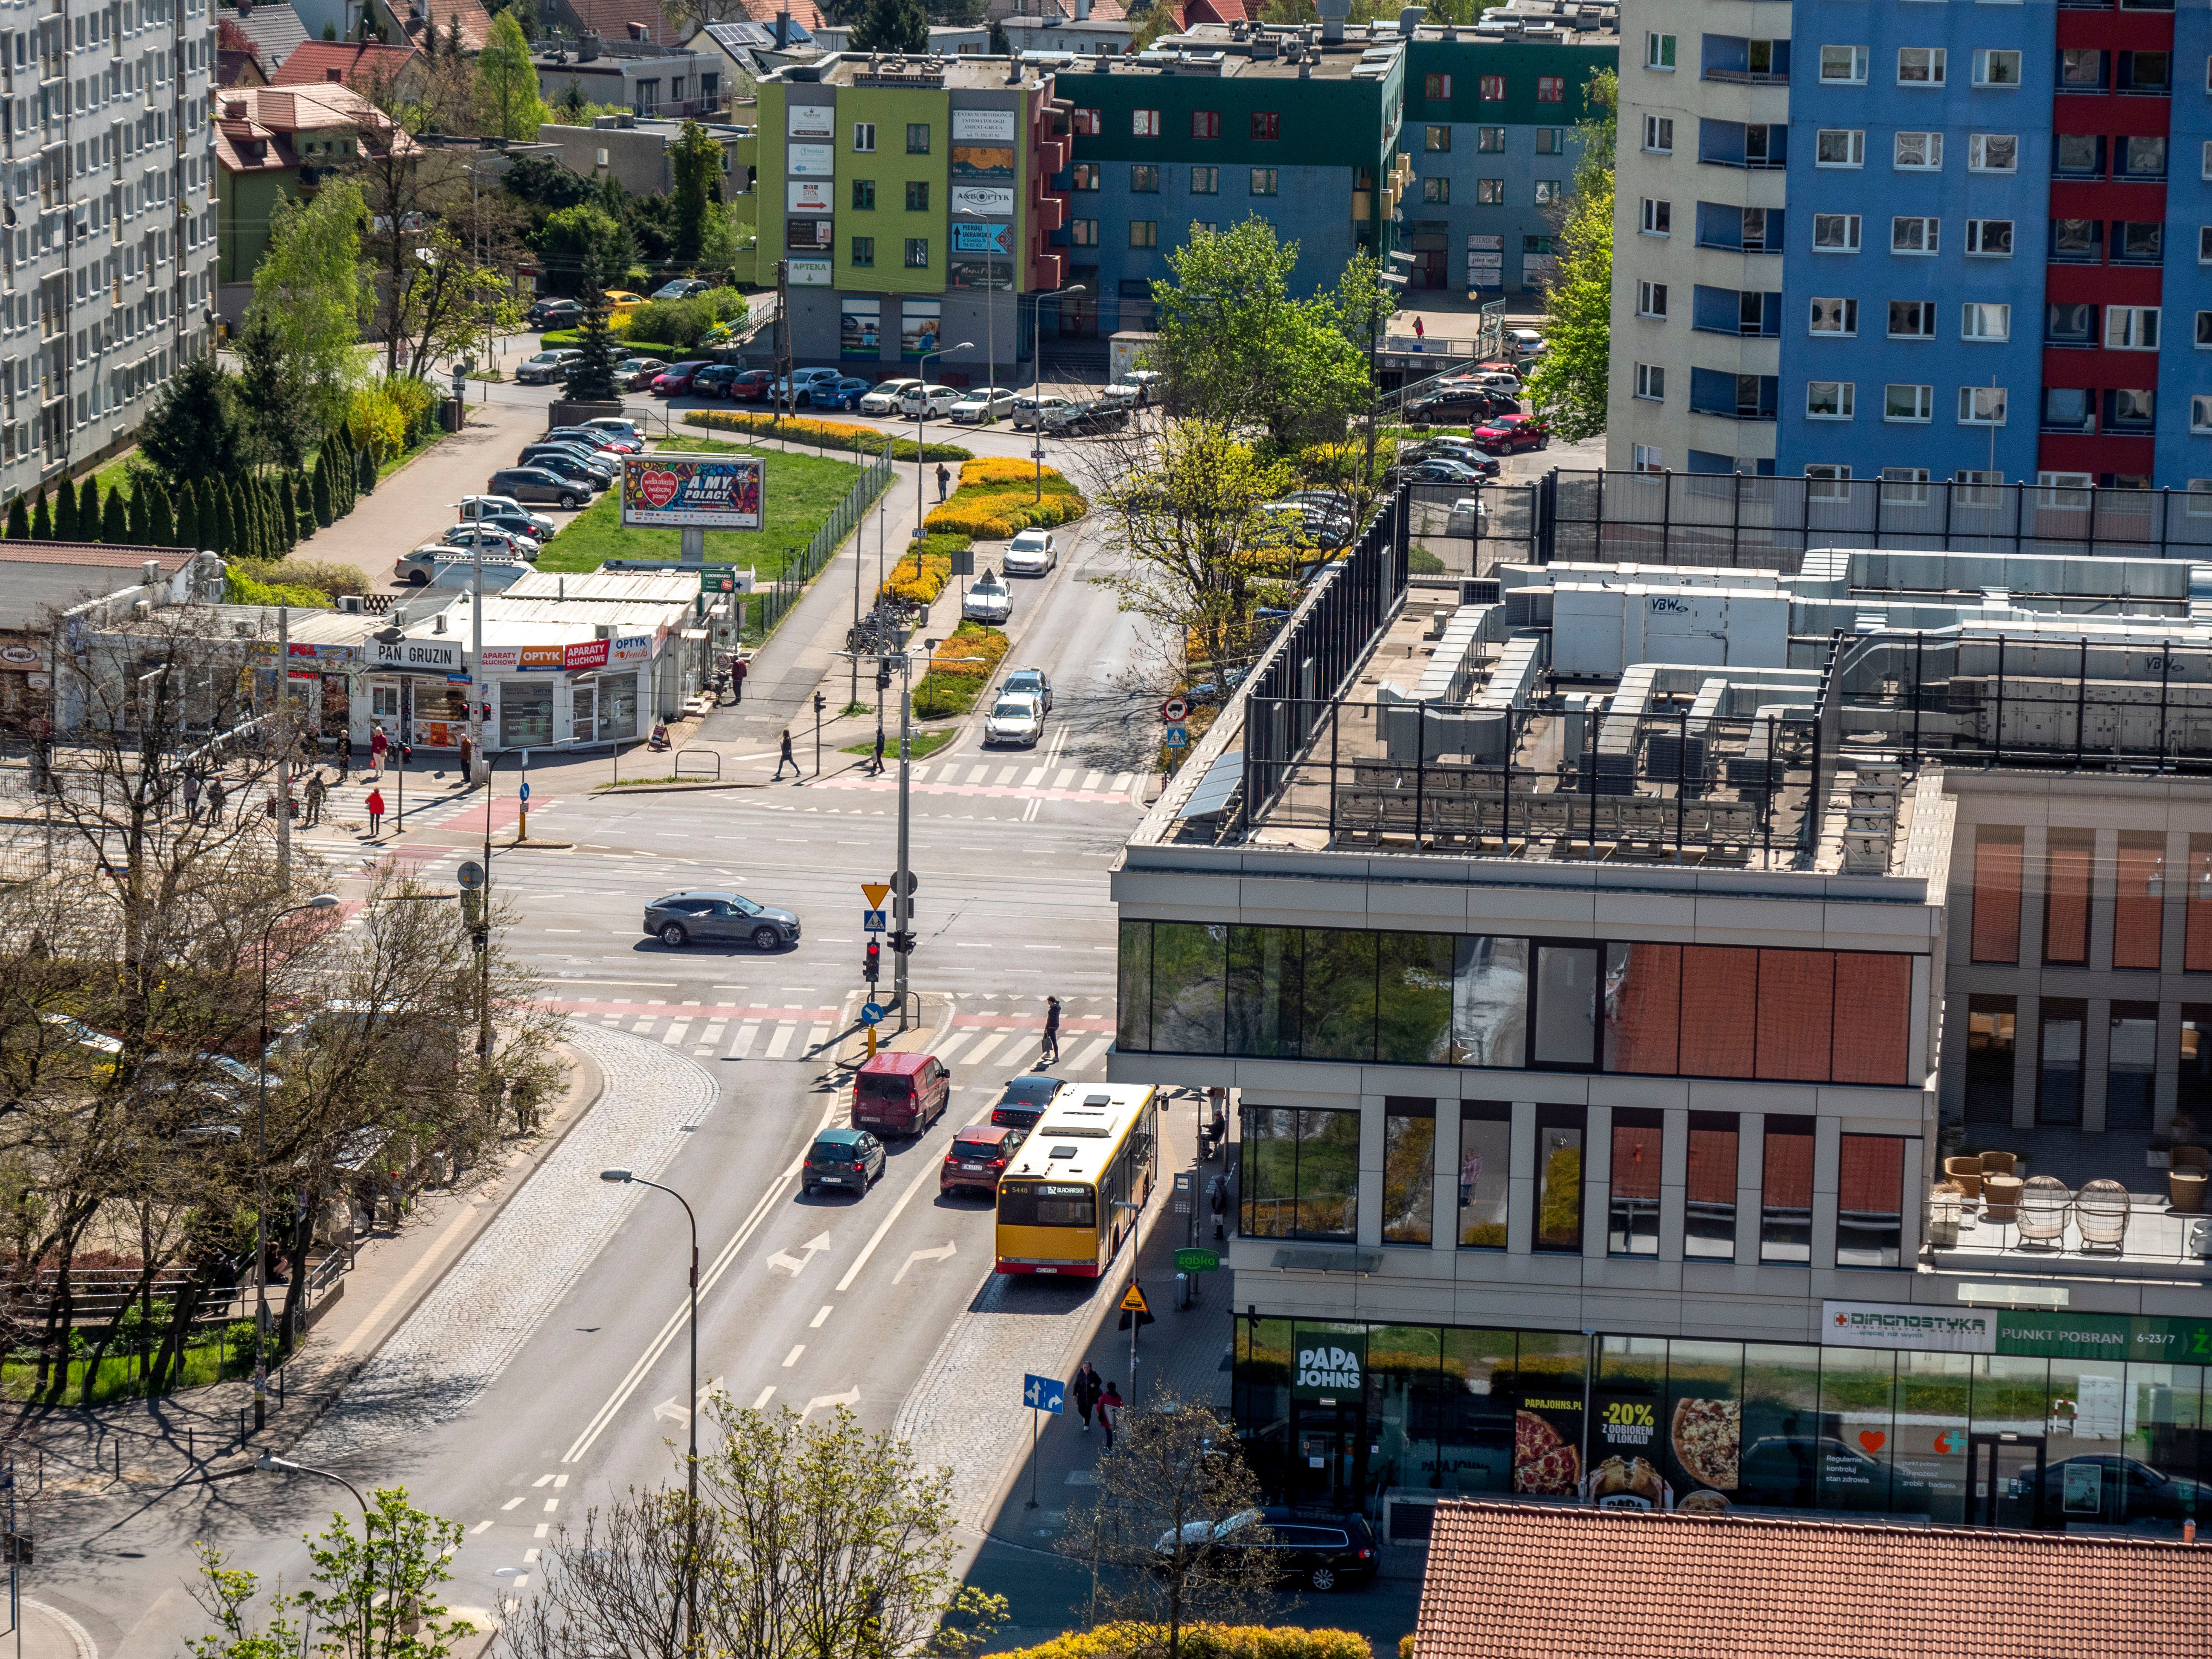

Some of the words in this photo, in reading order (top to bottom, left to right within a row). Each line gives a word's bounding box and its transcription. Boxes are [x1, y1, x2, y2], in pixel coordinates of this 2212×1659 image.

[687, 476, 700, 489] A
[704, 476, 733, 490] MY,
[684, 490, 729, 500] POLACY,
[1652, 598, 1679, 611] VBW
[616, 637, 646, 649] OPTYK
[379, 645, 402, 661] PAN
[410, 647, 451, 664] GRUZIN
[523, 651, 560, 661] OPTYK
[568, 644, 604, 657] APARATY
[567, 654, 605, 666] SŁUCHOWE
[1179, 1254, 1215, 1265] żabka
[2002, 1328, 2055, 1341] PUNKT
[2059, 1330, 2124, 1344] POBRAŃ
[2137, 1333, 2175, 1344] 6-23/7
[1300, 1347, 1360, 1371] PAPA
[1297, 1370, 1360, 1388] JOHNS
[1525, 1399, 1582, 1410] PAPAJOHNS.PL
[1602, 1403, 1654, 1426] -20%
[1602, 1424, 1607, 1433] Z
[1609, 1424, 1653, 1436] ODBIOREM
[1607, 1433, 1615, 1443] W
[1617, 1434, 1648, 1444] LOKALU
[1827, 1466, 1856, 1474] kontroluj
